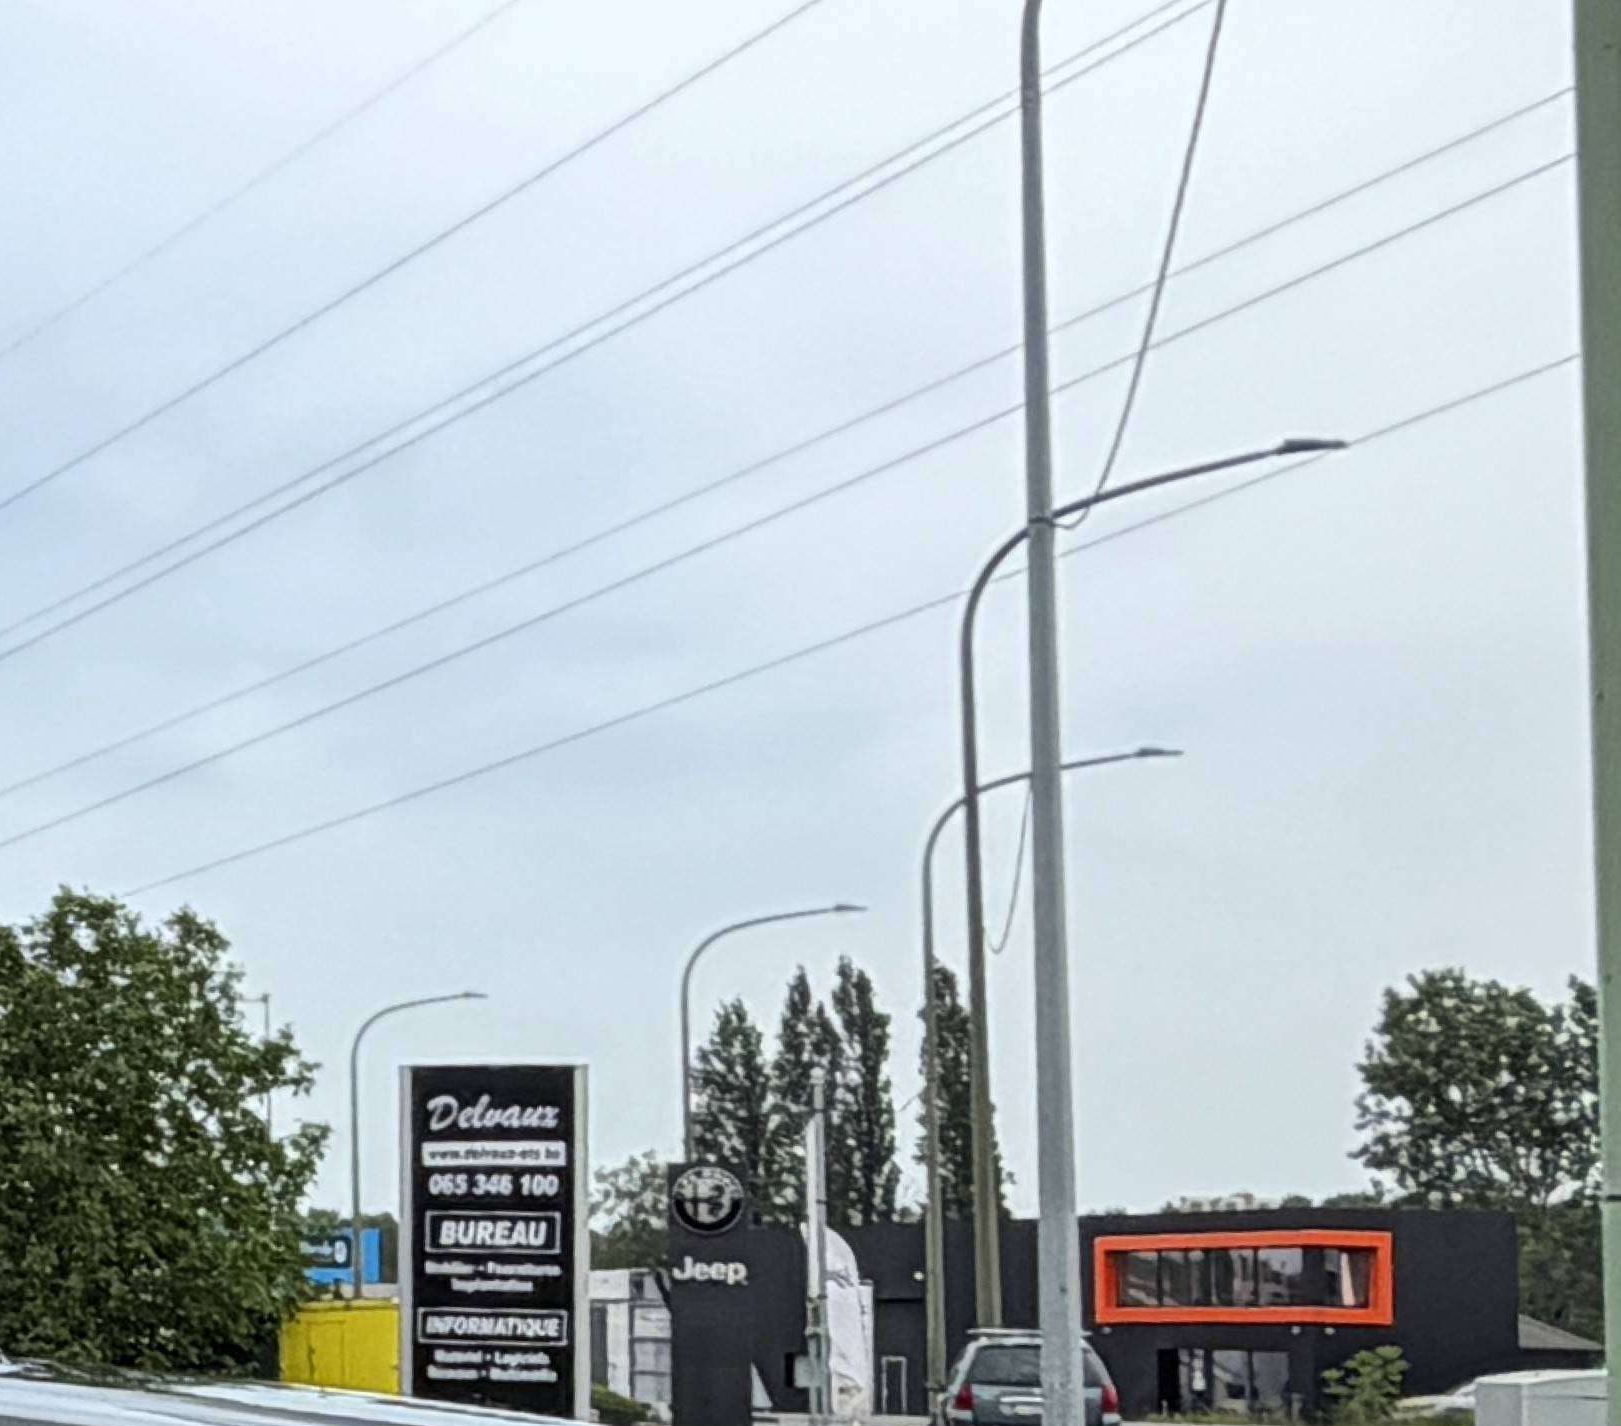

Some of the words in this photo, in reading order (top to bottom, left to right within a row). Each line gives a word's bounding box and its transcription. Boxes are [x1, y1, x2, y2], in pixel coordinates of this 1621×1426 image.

[426, 1094, 560, 1131] Delvaux
[428, 1173, 468, 1195] 065
[520, 1173, 559, 1196] 100
[439, 1219, 547, 1246] BUREAU
[672, 1255, 747, 1285] Jeep
[426, 1315, 559, 1336] INFORMATIQUE
